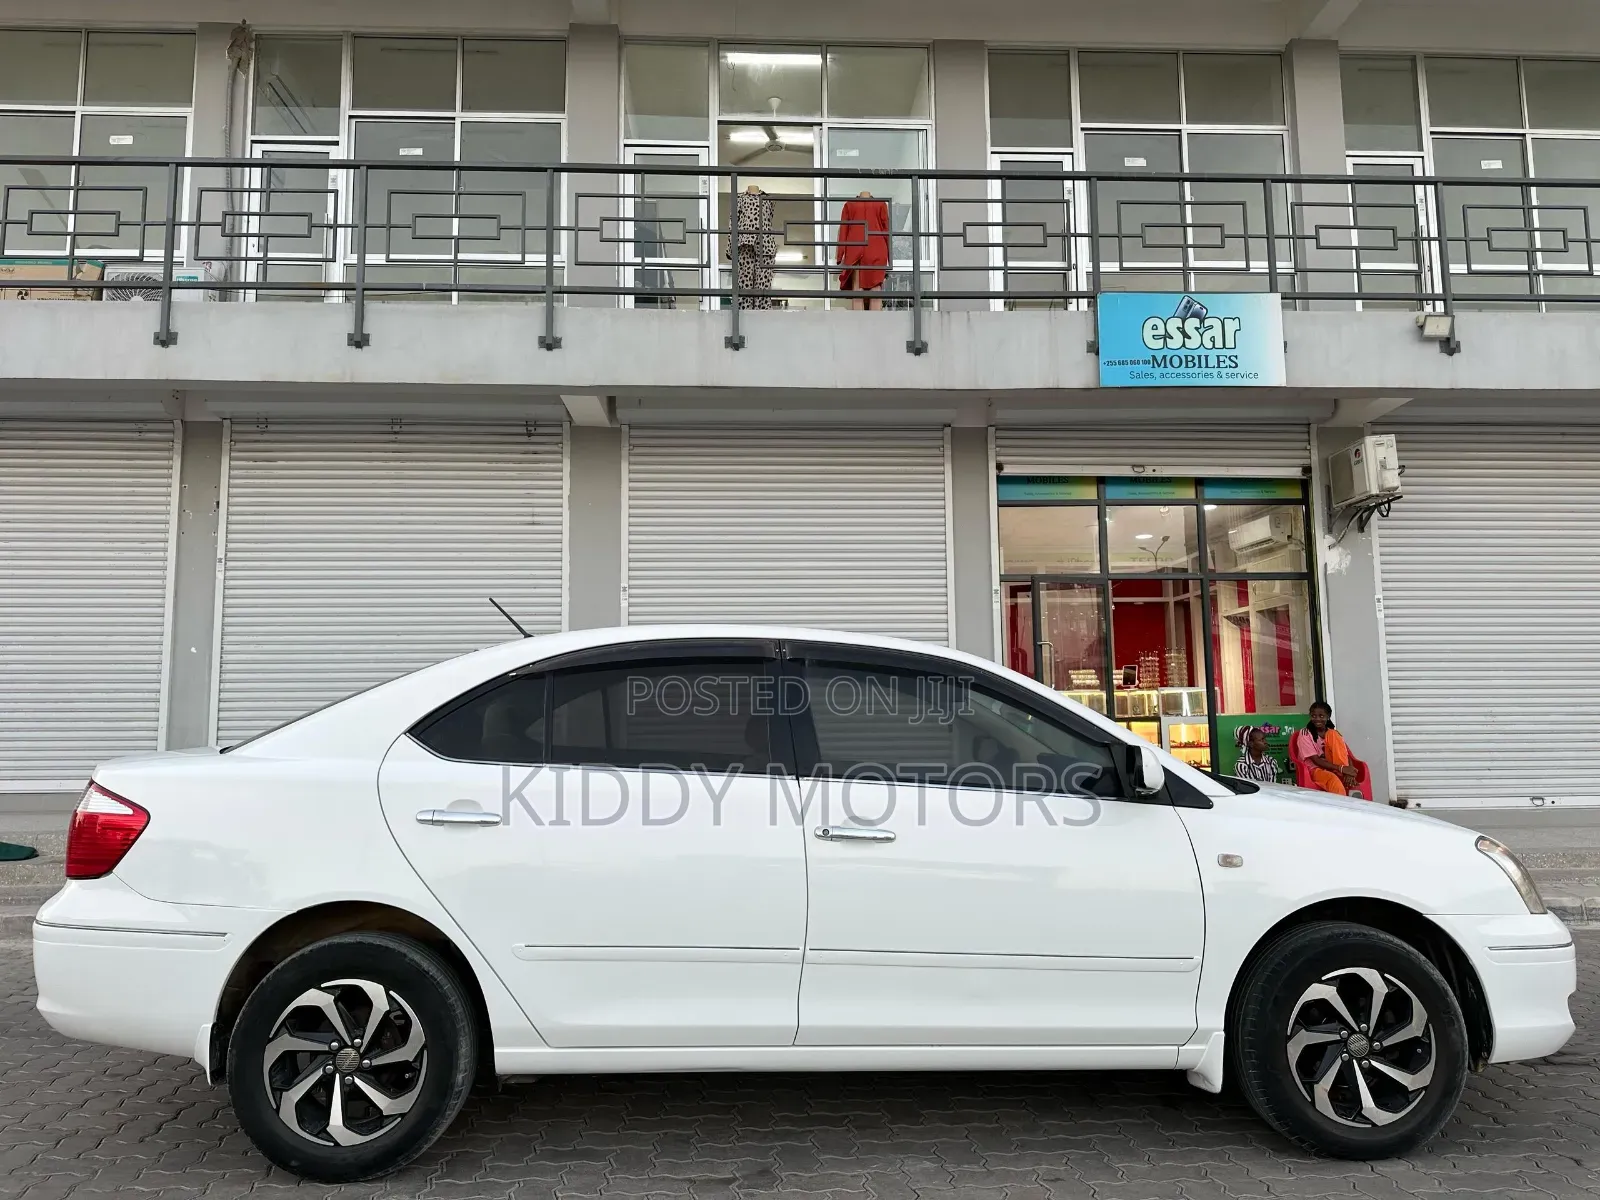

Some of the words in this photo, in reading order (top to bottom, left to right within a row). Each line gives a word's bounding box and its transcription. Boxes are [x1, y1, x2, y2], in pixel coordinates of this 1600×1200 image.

[1142, 316, 1241, 350] essar
[1151, 354, 1239, 369] MOBILES
[1129, 371, 1157, 380] Sales,
[1159, 370, 1214, 380] accessories
[1216, 370, 1223, 379] &
[1225, 370, 1259, 380] service
